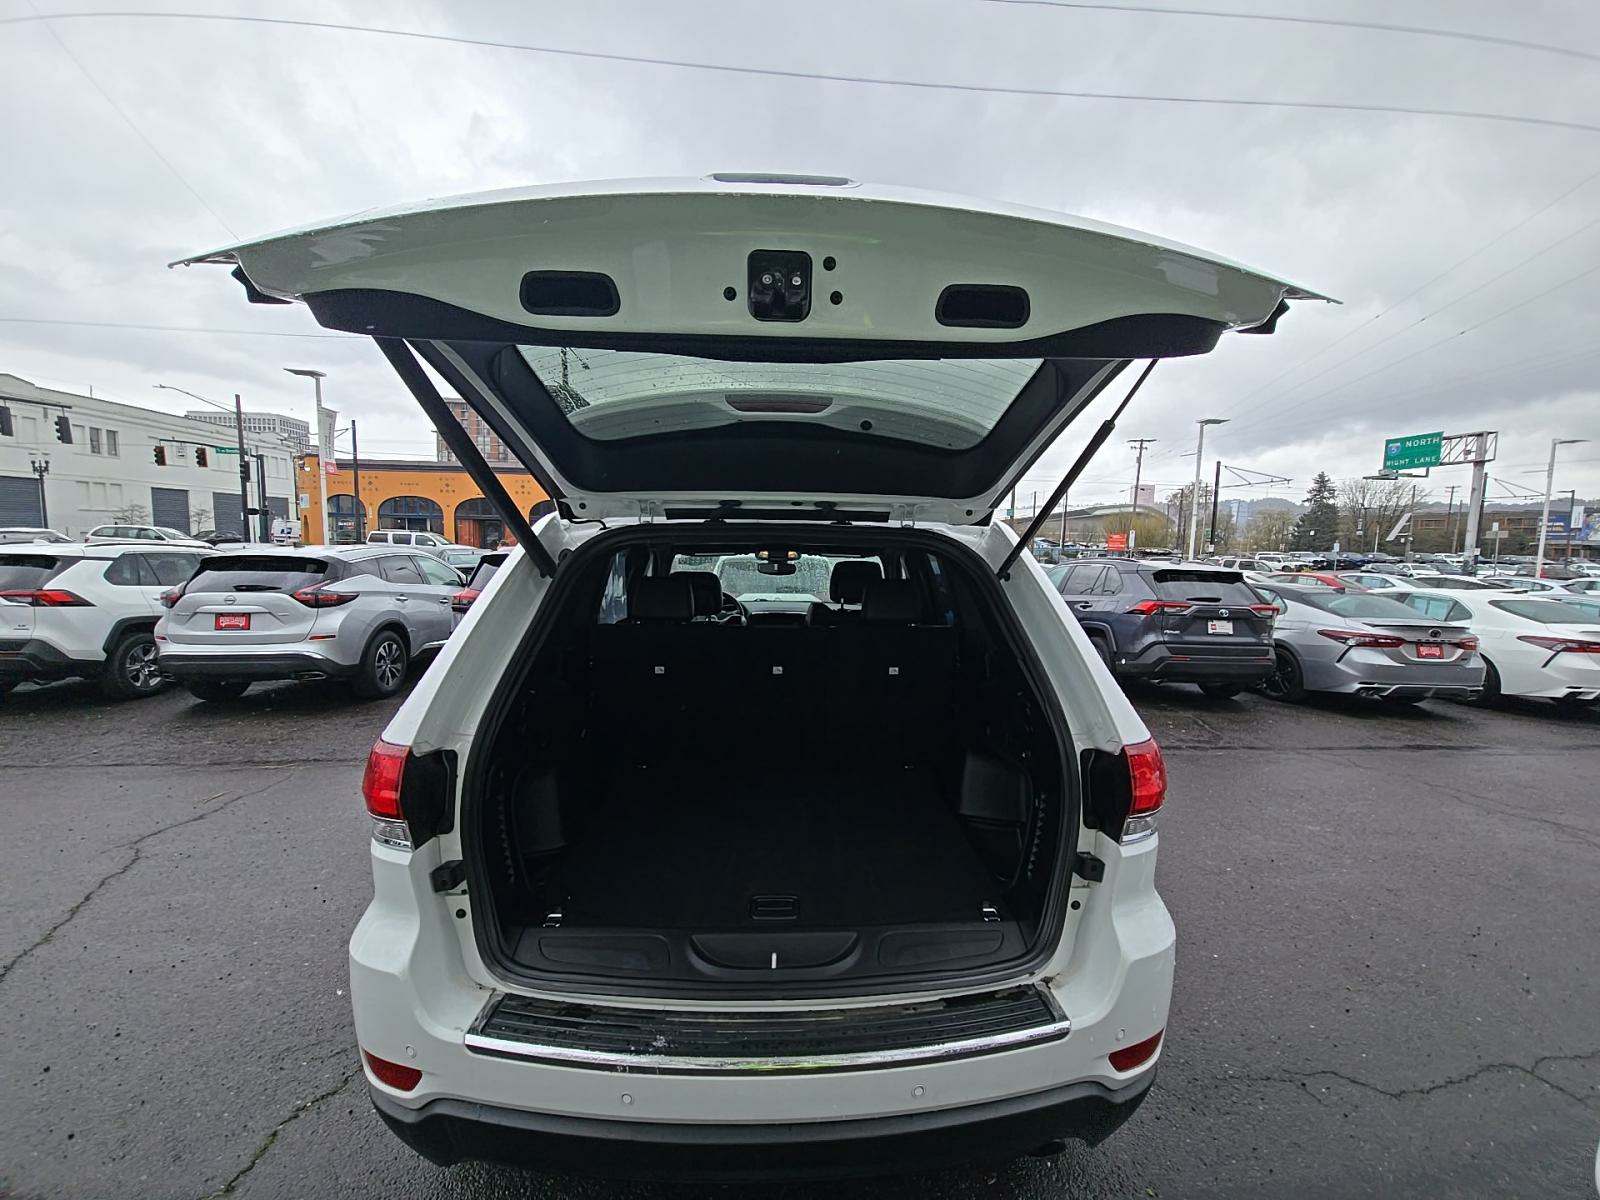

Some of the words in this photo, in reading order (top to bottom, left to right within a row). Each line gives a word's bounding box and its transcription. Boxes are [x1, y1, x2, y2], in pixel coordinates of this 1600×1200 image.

[1405, 437, 1440, 448] NORTH
[1386, 458, 1410, 467] RIGHT
[1414, 455, 1437, 464] LANE
